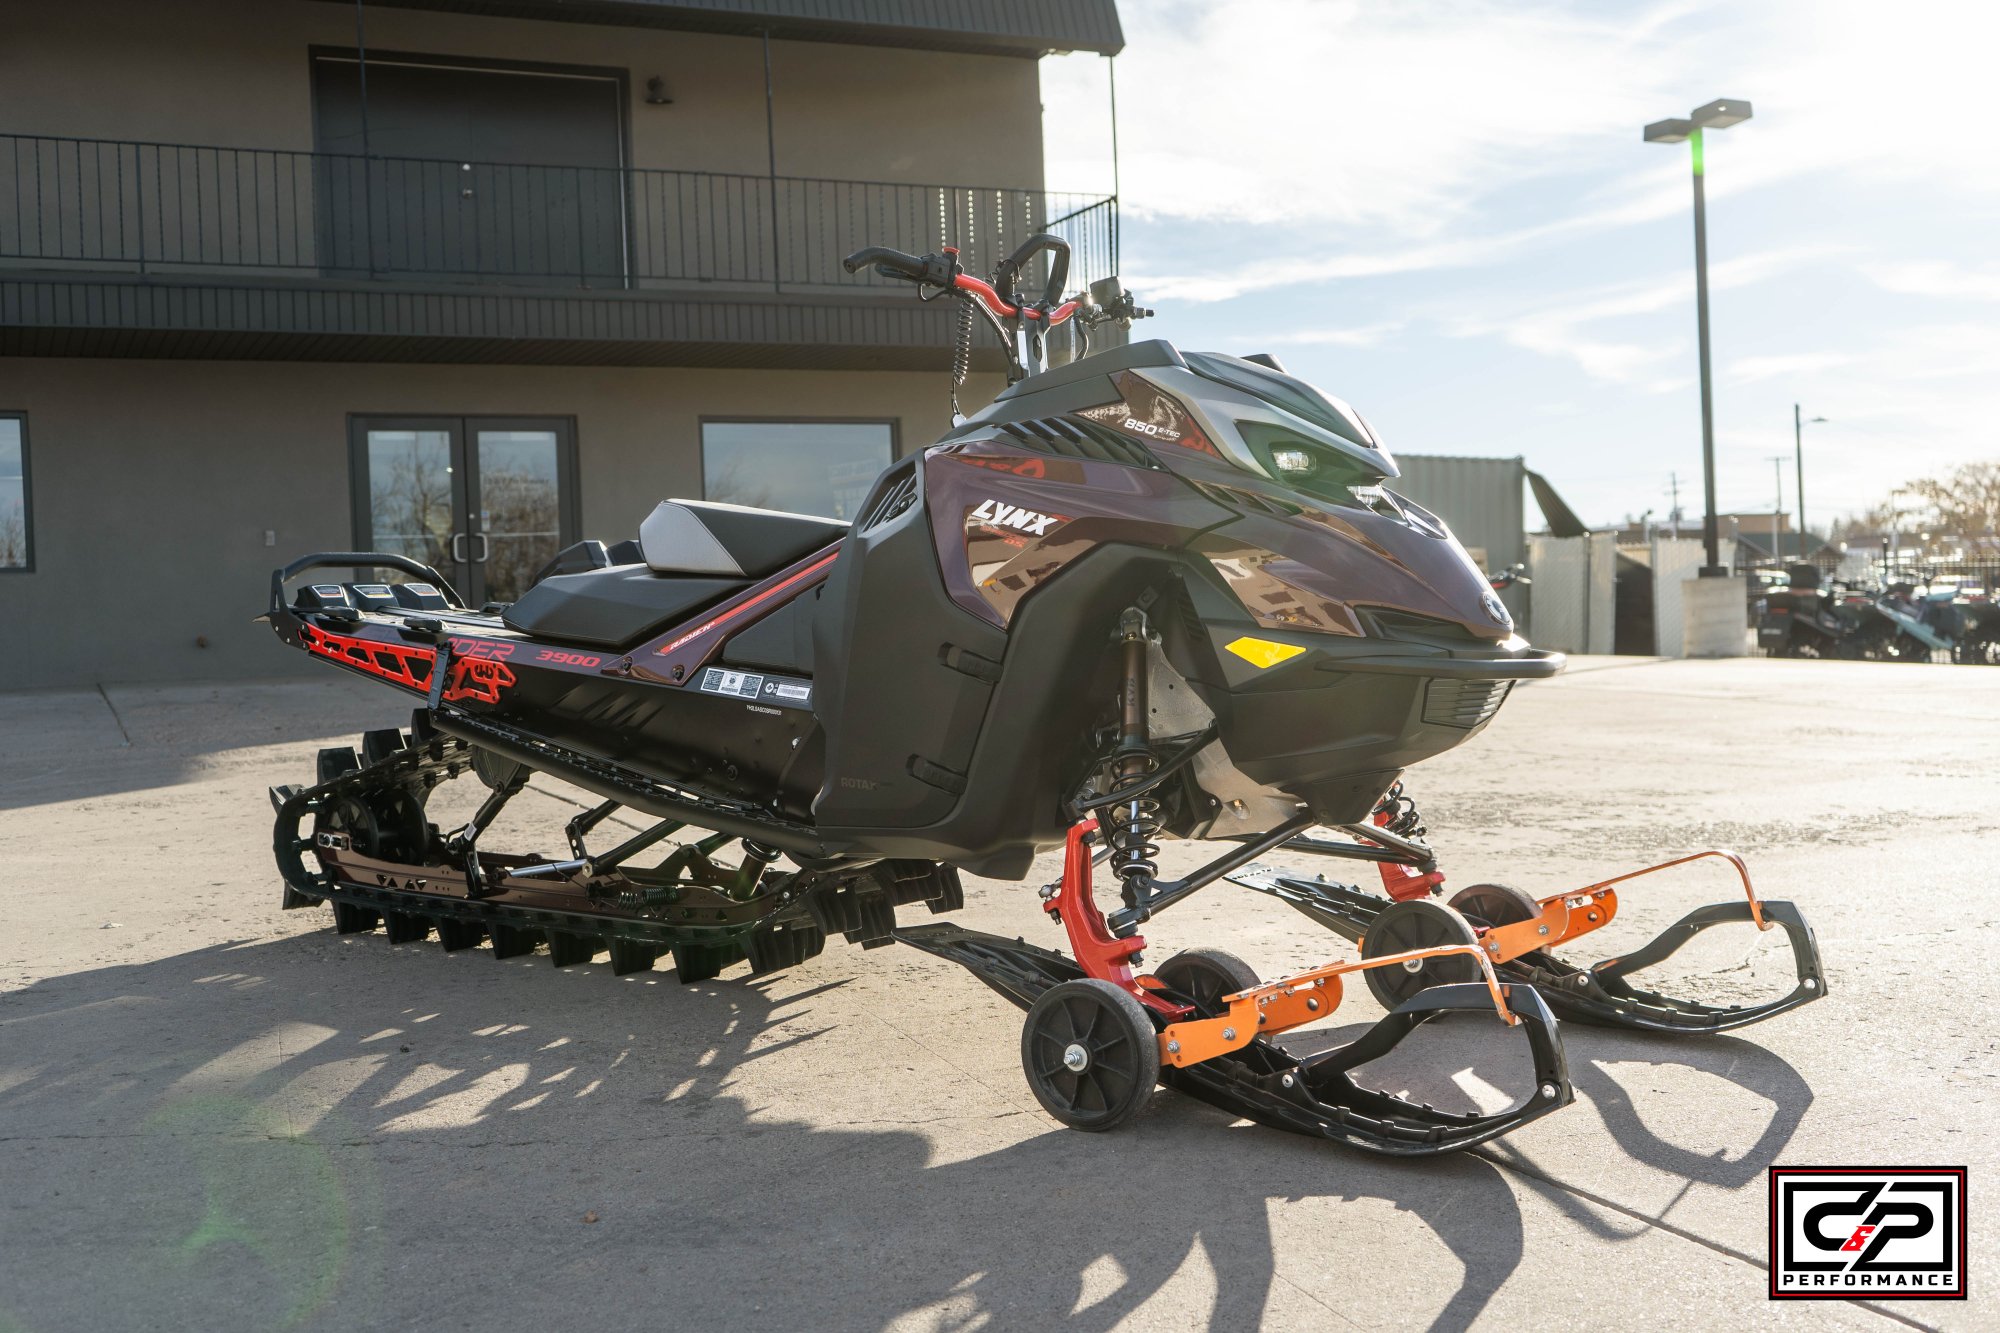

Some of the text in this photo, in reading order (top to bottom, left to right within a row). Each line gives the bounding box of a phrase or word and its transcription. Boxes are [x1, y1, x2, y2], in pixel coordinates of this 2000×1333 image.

[1124, 418, 1158, 436] 850
[971, 498, 1059, 537] LYNX
[535, 649, 601, 668] 3900
